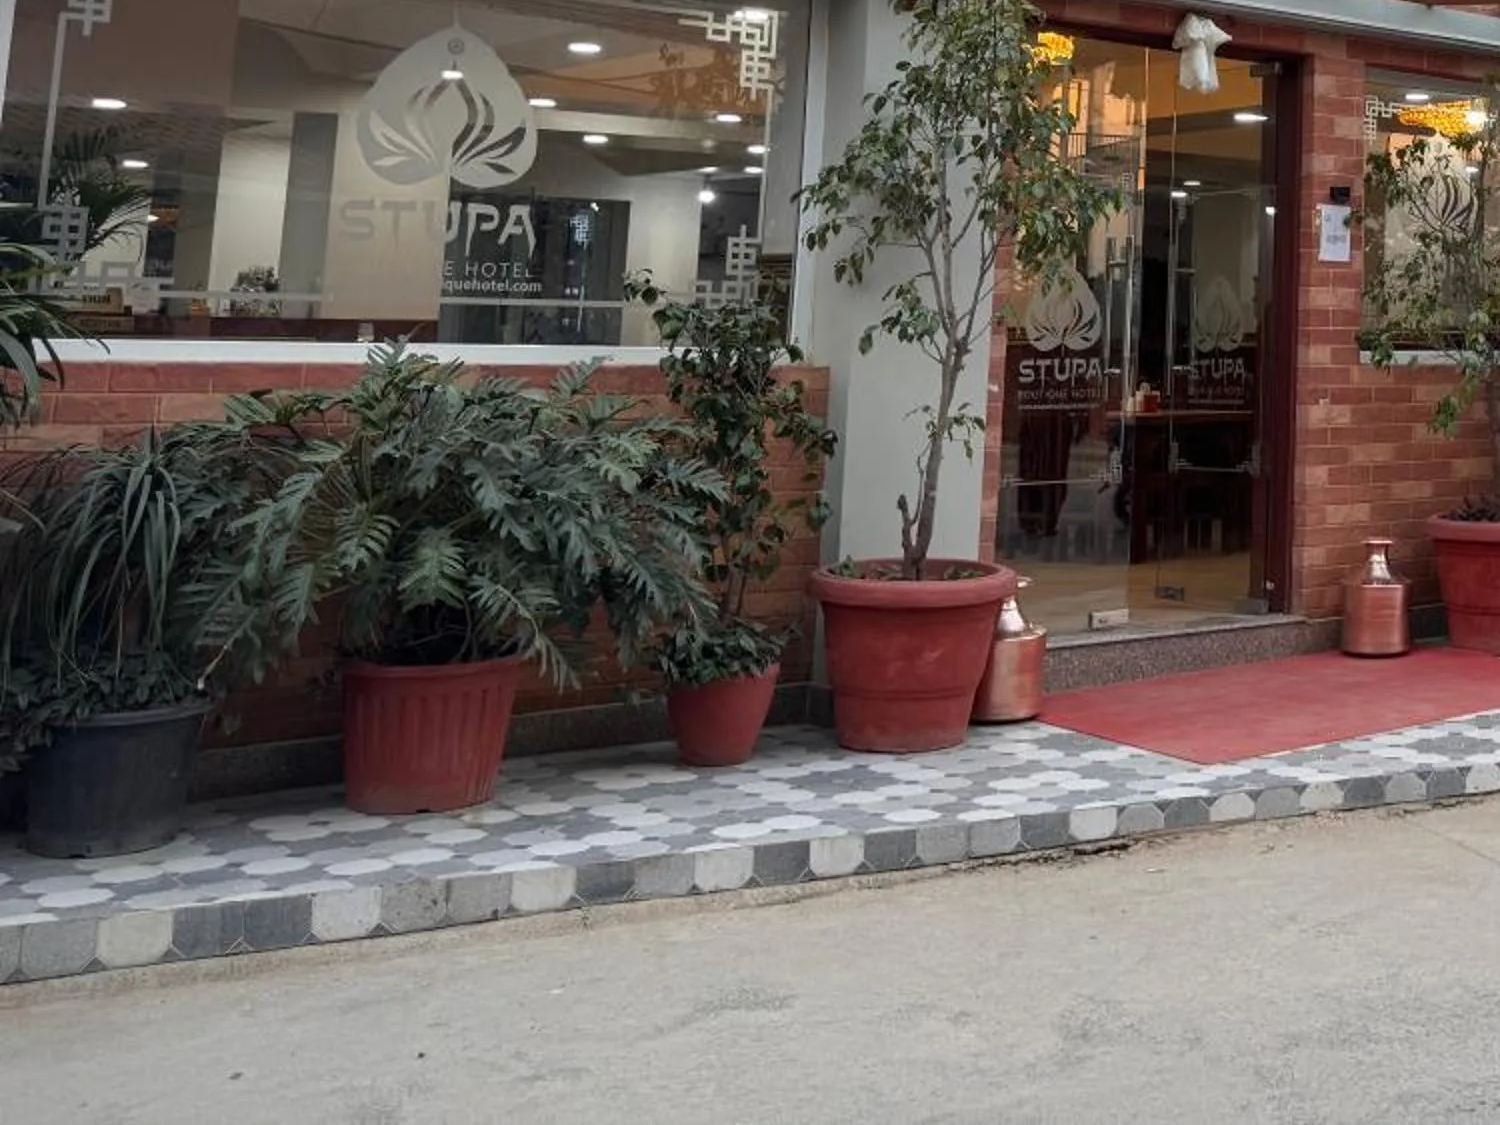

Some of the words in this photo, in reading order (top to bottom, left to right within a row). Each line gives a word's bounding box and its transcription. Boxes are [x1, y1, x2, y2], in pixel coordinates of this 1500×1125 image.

[340, 199, 537, 259] STUPA
[464, 261, 535, 278] HOTEL
[1019, 358, 1103, 390] STUPA
